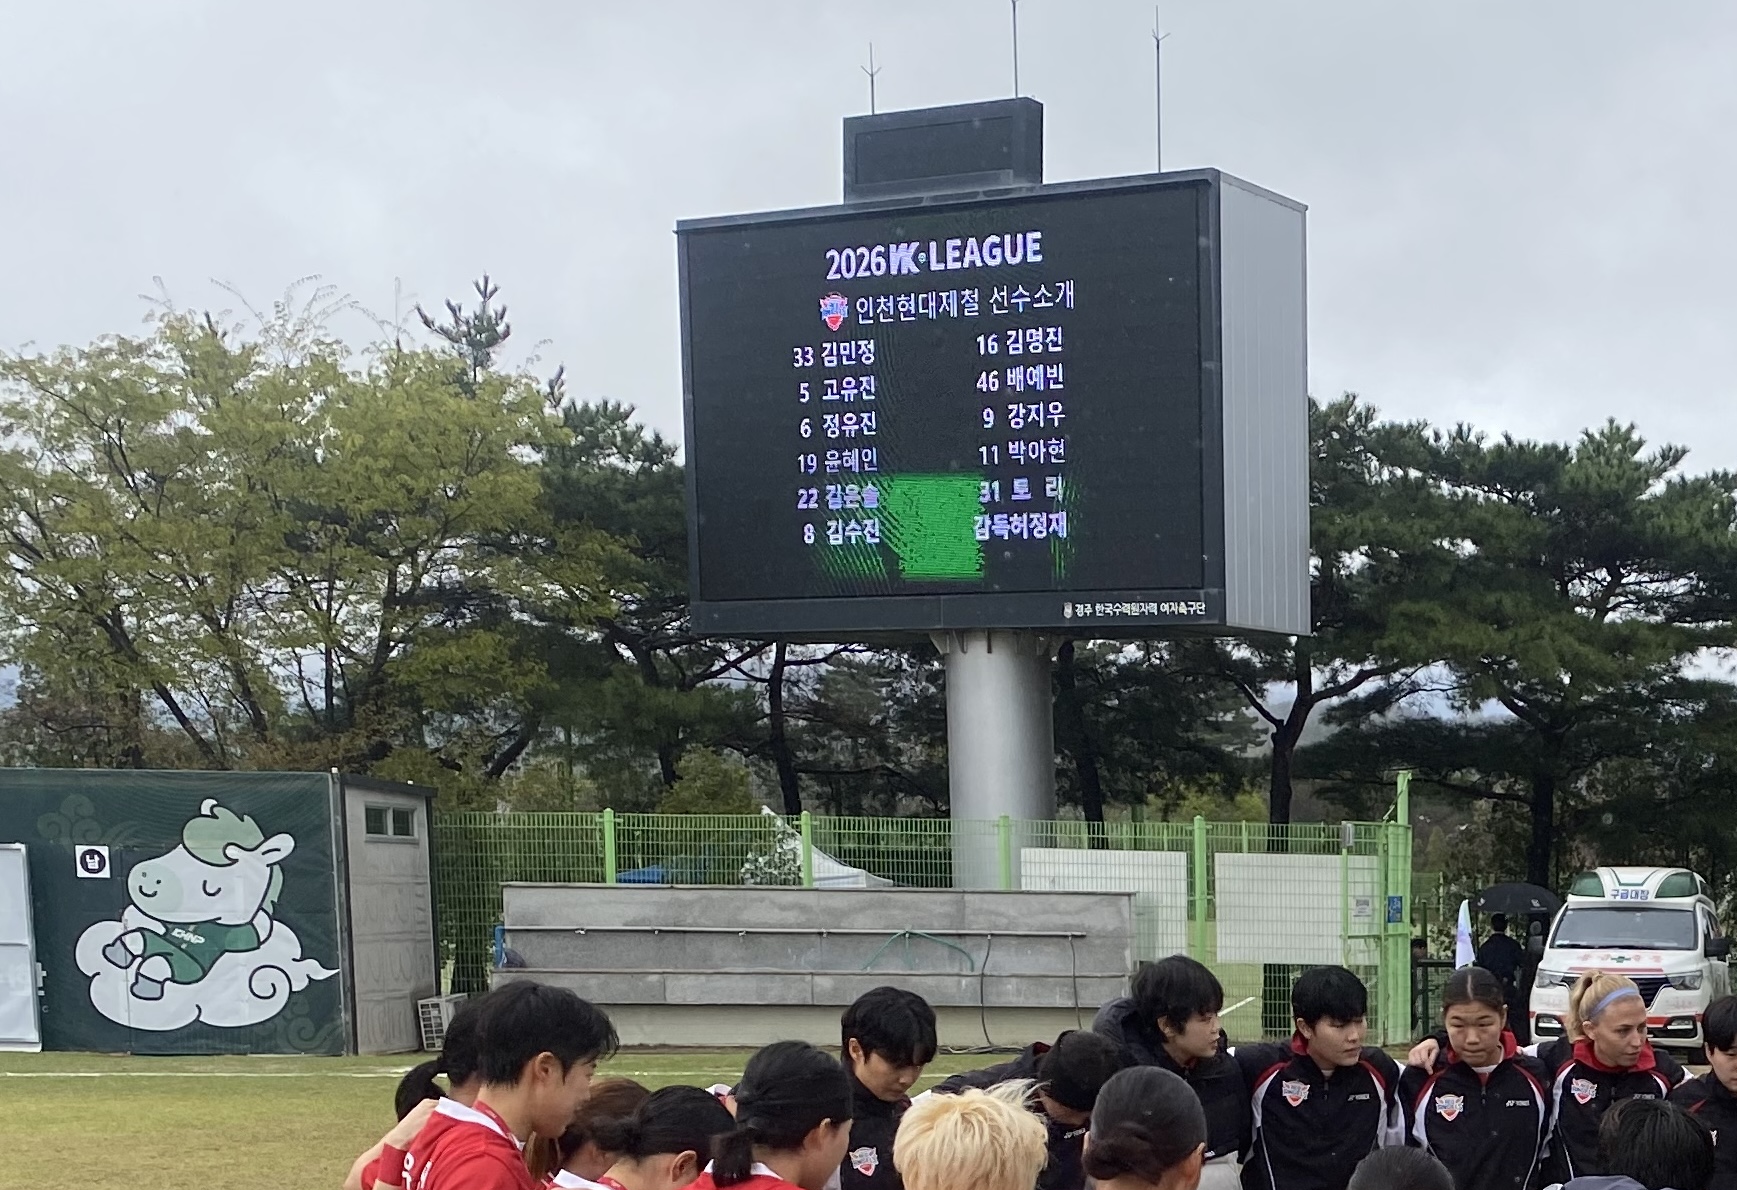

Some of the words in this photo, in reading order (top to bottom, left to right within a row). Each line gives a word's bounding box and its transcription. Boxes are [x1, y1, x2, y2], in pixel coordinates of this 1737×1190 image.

[855, 288, 979, 325] 인천현대제철
[989, 279, 1075, 315] 선수소개
[793, 346, 814, 367] 33
[821, 339, 875, 367] 김민정
[976, 333, 999, 356] 16
[1006, 326, 1063, 355] 김명진
[799, 382, 810, 403] 5
[822, 375, 876, 402] 고유진
[976, 370, 999, 392] 46
[1006, 363, 1064, 392] 배예빈
[800, 418, 812, 438] 6
[822, 411, 877, 438] 정유진
[982, 407, 995, 429] 9
[1007, 401, 1066, 429] 강지우
[797, 453, 818, 475] 19
[824, 446, 878, 473] 윤혜인
[978, 445, 999, 465] 11
[1008, 437, 1066, 465] 박아현
[797, 487, 819, 509] 22
[979, 479, 1001, 503] 31
[803, 523, 815, 544] 8
[826, 517, 881, 545] 김수진
[1075, 603, 1093, 617] 경주
[1094, 602, 1158, 617] 한국수력원자력
